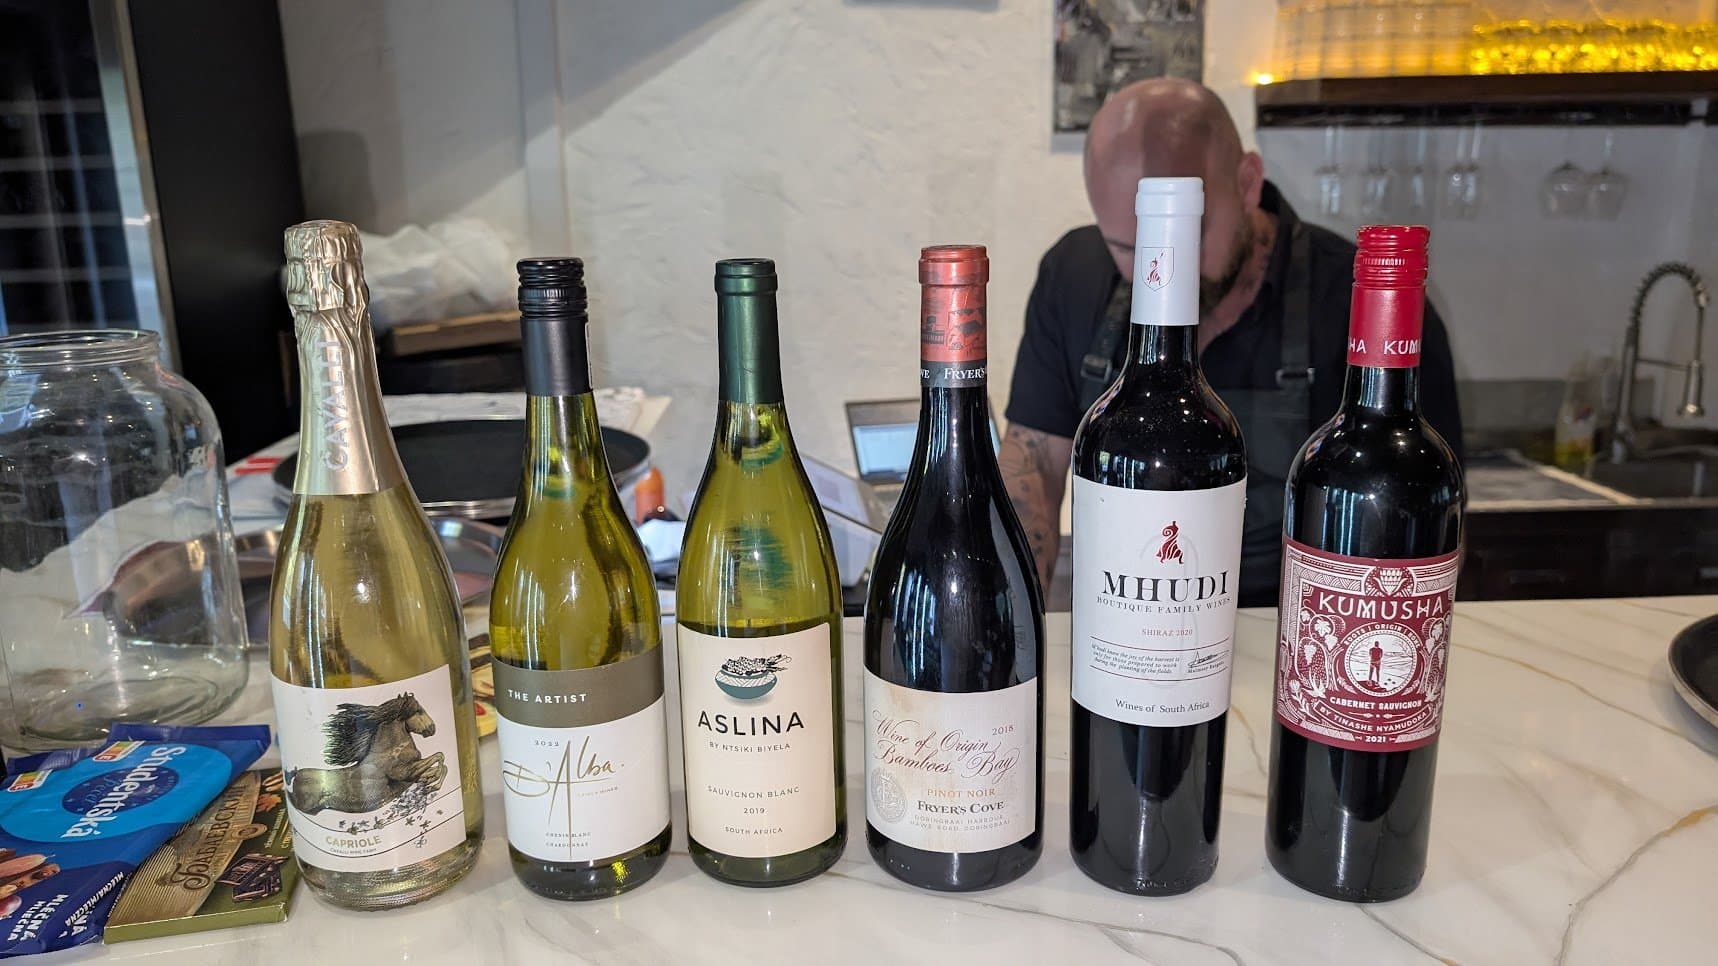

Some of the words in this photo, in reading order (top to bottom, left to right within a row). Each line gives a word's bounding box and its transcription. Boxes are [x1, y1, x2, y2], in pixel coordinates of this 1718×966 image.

[315, 340, 349, 471] CAVALLI
[1102, 569, 1229, 603] MHUDI
[1097, 595, 1153, 613] BOUTIQUE
[1158, 604, 1202, 614] FAMILY
[1318, 591, 1445, 620] KUMUSHA
[1142, 628, 1174, 637] SHIRAZ
[1176, 628, 1194, 636] 2020
[1345, 628, 1366, 646] ROOTS
[1374, 623, 1403, 632] ORIGIN
[507, 689, 529, 702] THE
[535, 693, 587, 704] ARTIST
[1330, 696, 1376, 710] CABERNET
[1378, 700, 1422, 711] SAUVIGNON
[1115, 698, 1144, 712] Wines
[1145, 703, 1157, 712] of
[1159, 704, 1186, 713] South
[1187, 700, 1210, 712] Africa
[698, 710, 804, 736] ASLINA
[1319, 706, 1332, 717] BY
[1334, 714, 1373, 732] TINASHE
[1376, 711, 1427, 732] NYAMUDOKA
[872, 710, 920, 743] Wine
[915, 731, 937, 756] of
[940, 729, 1002, 762] Origin
[992, 725, 1014, 736] 2018
[534, 739, 560, 747] 2022
[1365, 735, 1386, 743] 2021
[709, 741, 719, 749] BY
[722, 744, 753, 753] NTSIKI
[758, 743, 791, 753] BIYELA
[873, 740, 950, 774] Bamboes
[960, 747, 1021, 784] Bay
[60, 746, 187, 838] Studentská
[708, 785, 763, 799] SAUVIGNON
[767, 786, 800, 798] BLANC
[927, 788, 962, 798] PINOT
[967, 788, 996, 798] NOIR
[917, 800, 967, 816] FRYER'S
[970, 801, 1005, 814] COVE
[725, 826, 750, 835] SOUTH
[753, 827, 783, 835] AFRICA
[325, 835, 382, 849] CAPRIOLE
